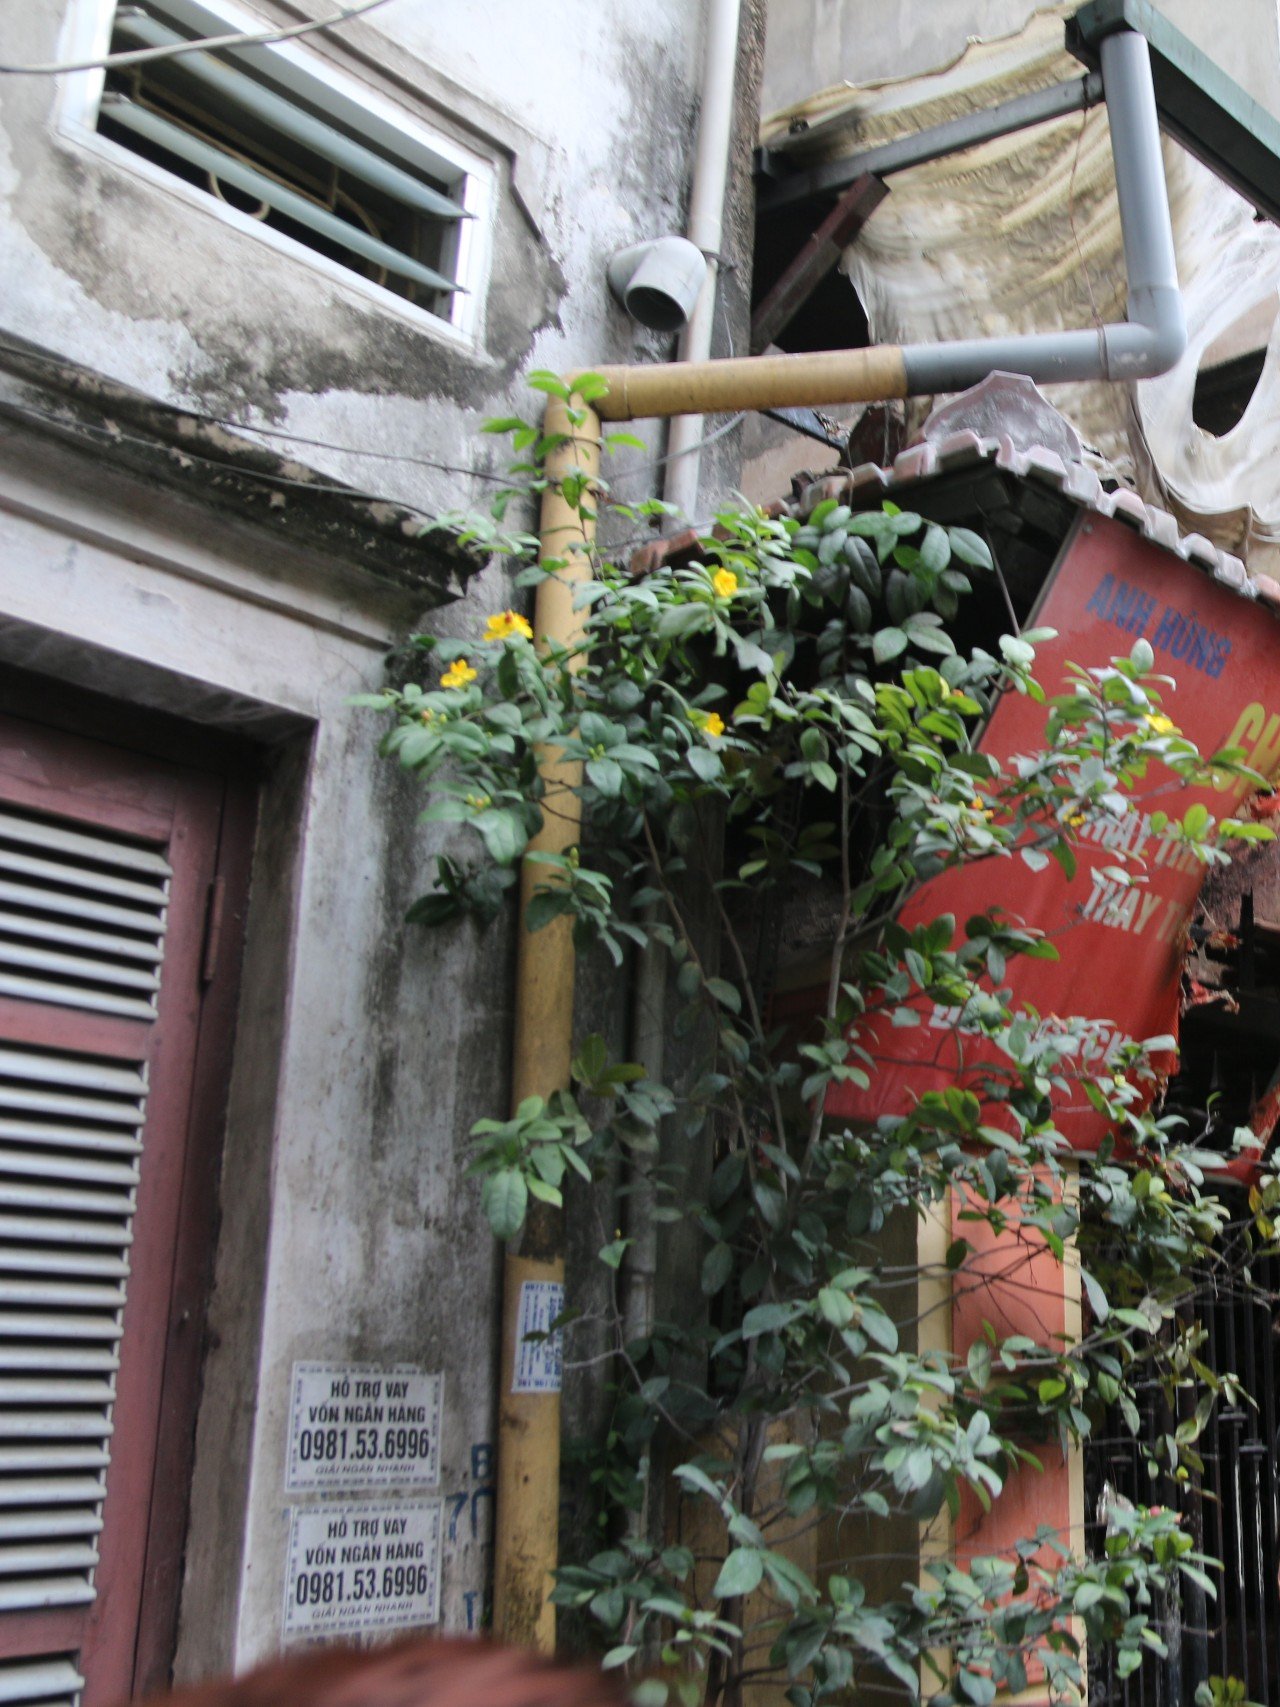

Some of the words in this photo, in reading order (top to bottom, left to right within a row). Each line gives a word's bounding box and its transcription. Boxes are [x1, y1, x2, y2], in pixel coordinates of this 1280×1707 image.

[1086, 573, 1157, 637] ANH
[385, 1380, 409, 1398] VAY
[344, 1402, 384, 1423] NGÂN
[300, 1428, 430, 1461] 0981.53.6996
[383, 1517, 408, 1535] VAY
[341, 1541, 381, 1563] NGÂN
[296, 1564, 428, 1605] 0981.53.6996
